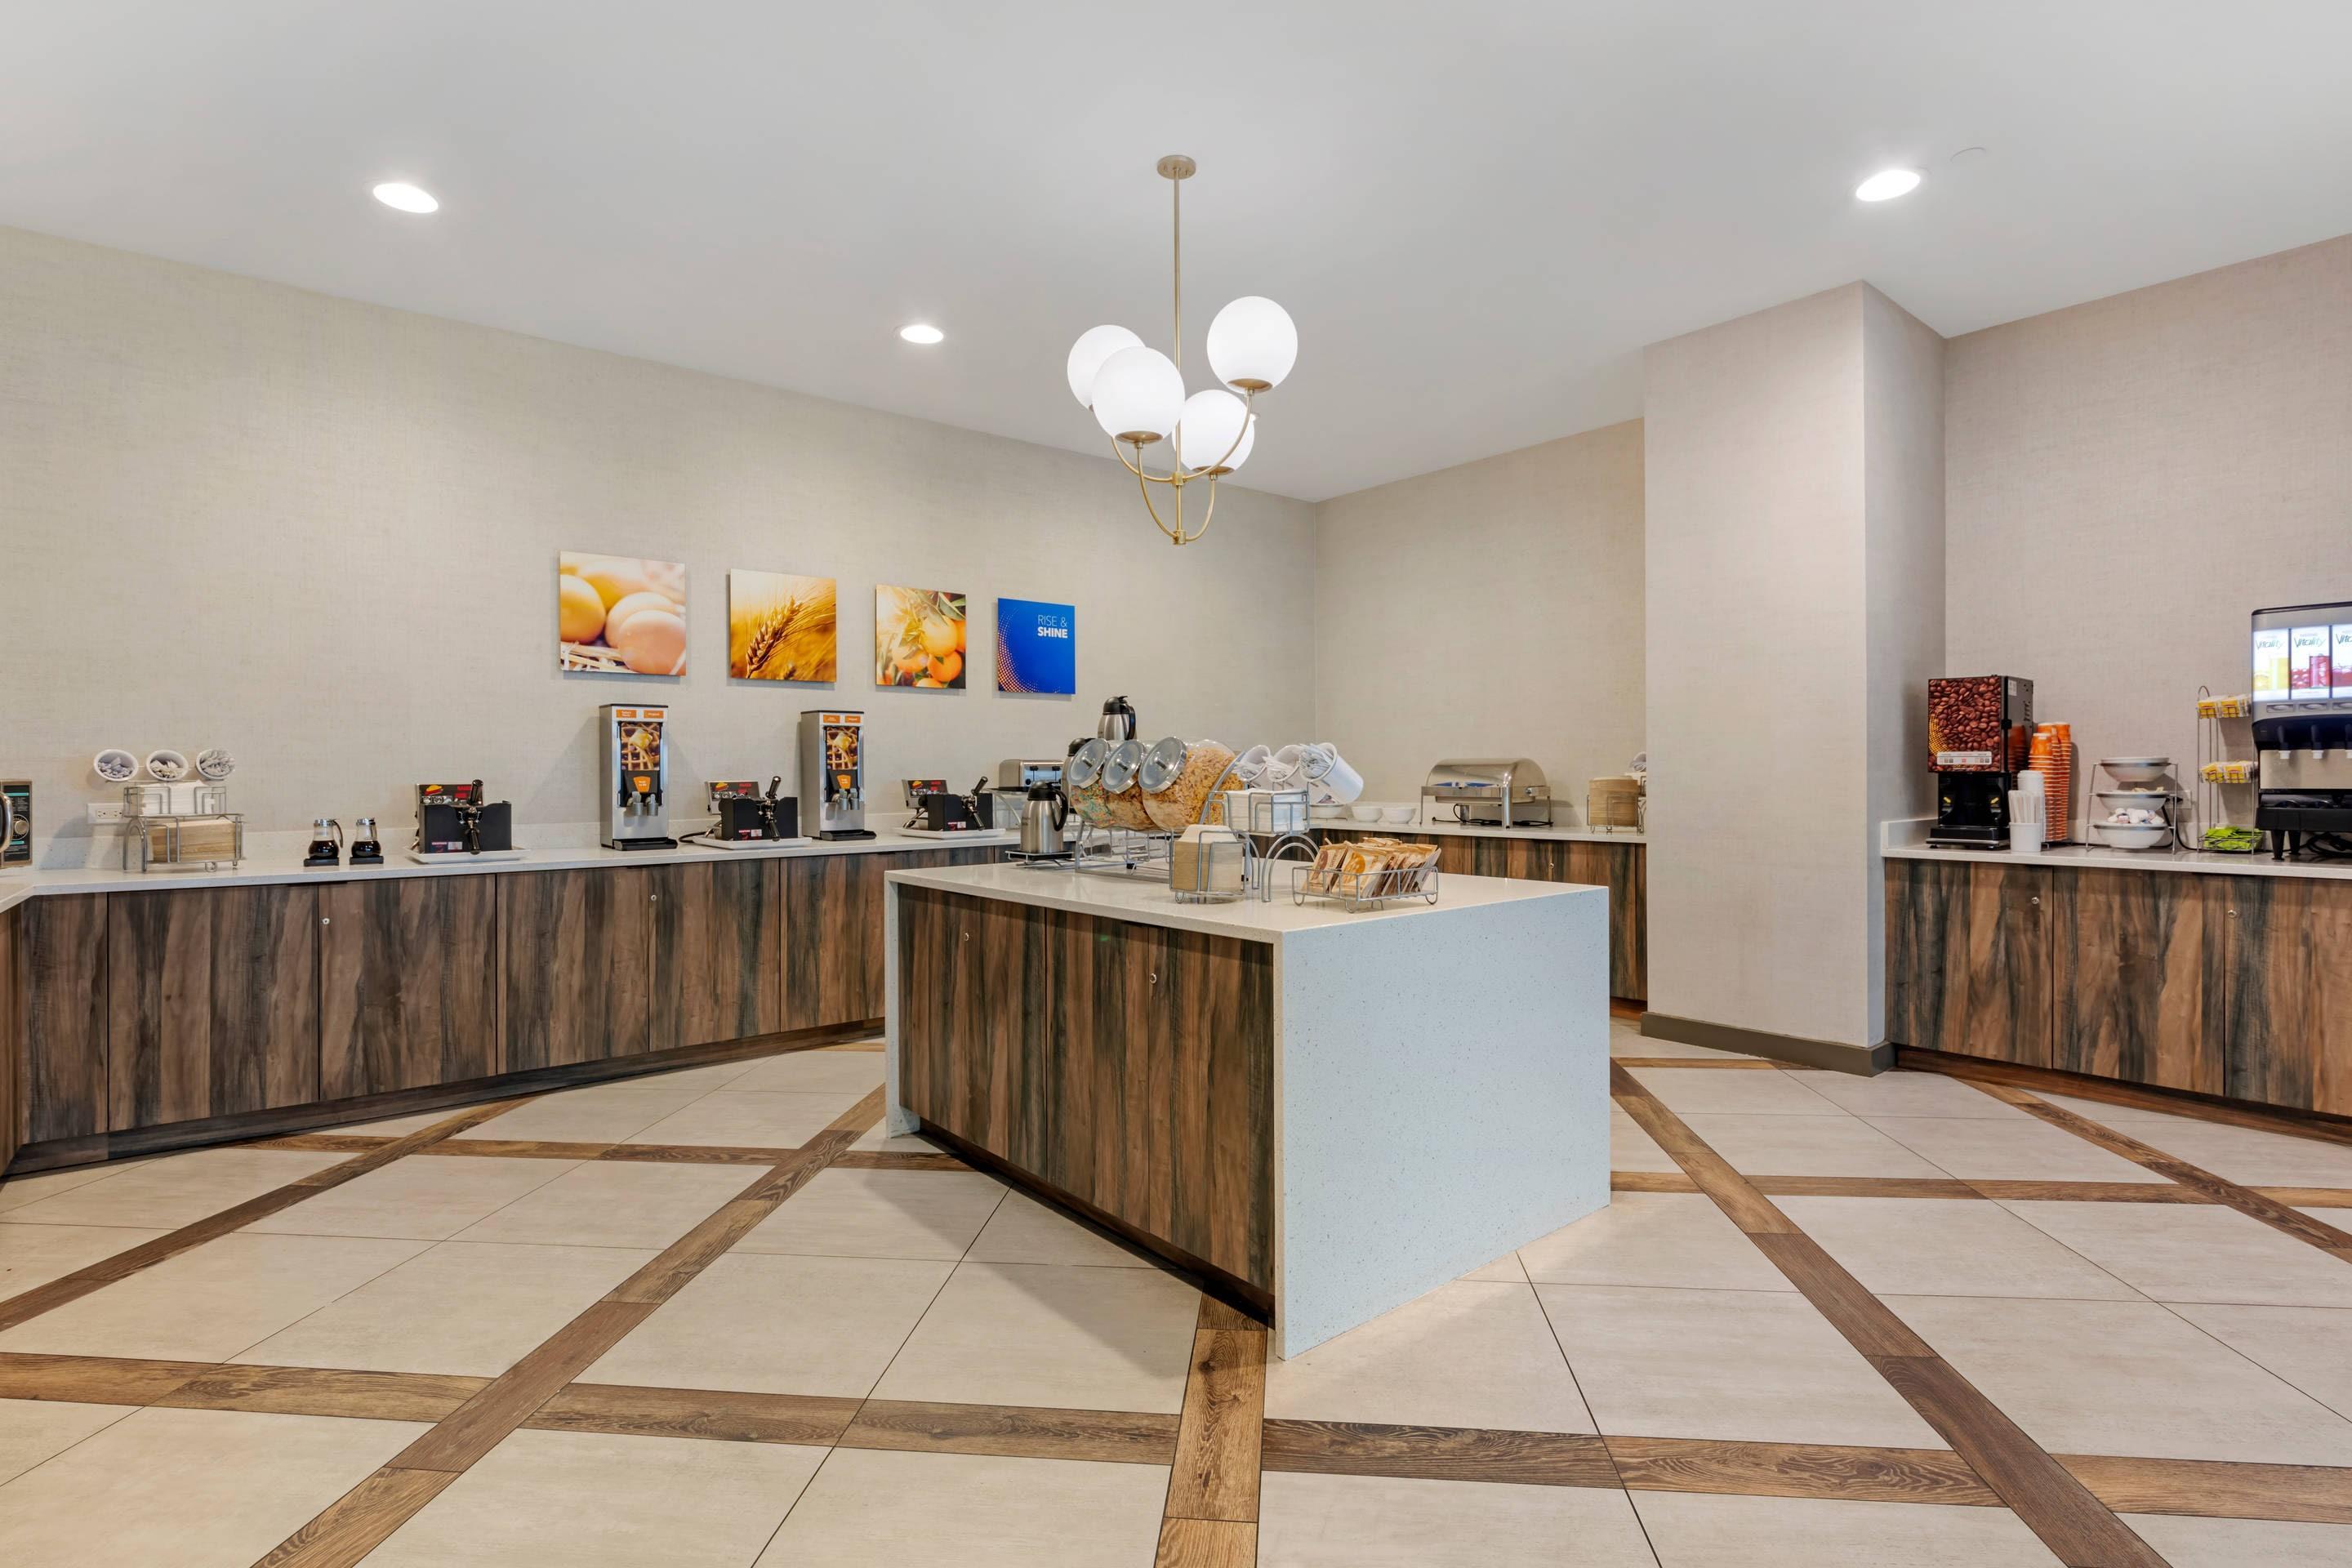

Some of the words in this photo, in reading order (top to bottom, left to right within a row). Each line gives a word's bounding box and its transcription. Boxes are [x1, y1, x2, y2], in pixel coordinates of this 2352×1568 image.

[1038, 614, 1058, 626] RISE
[1060, 617, 1067, 628] &
[1037, 626, 1068, 639] SHINE
[2255, 639, 2286, 650] Vitality
[2293, 637, 2327, 648] Vitality
